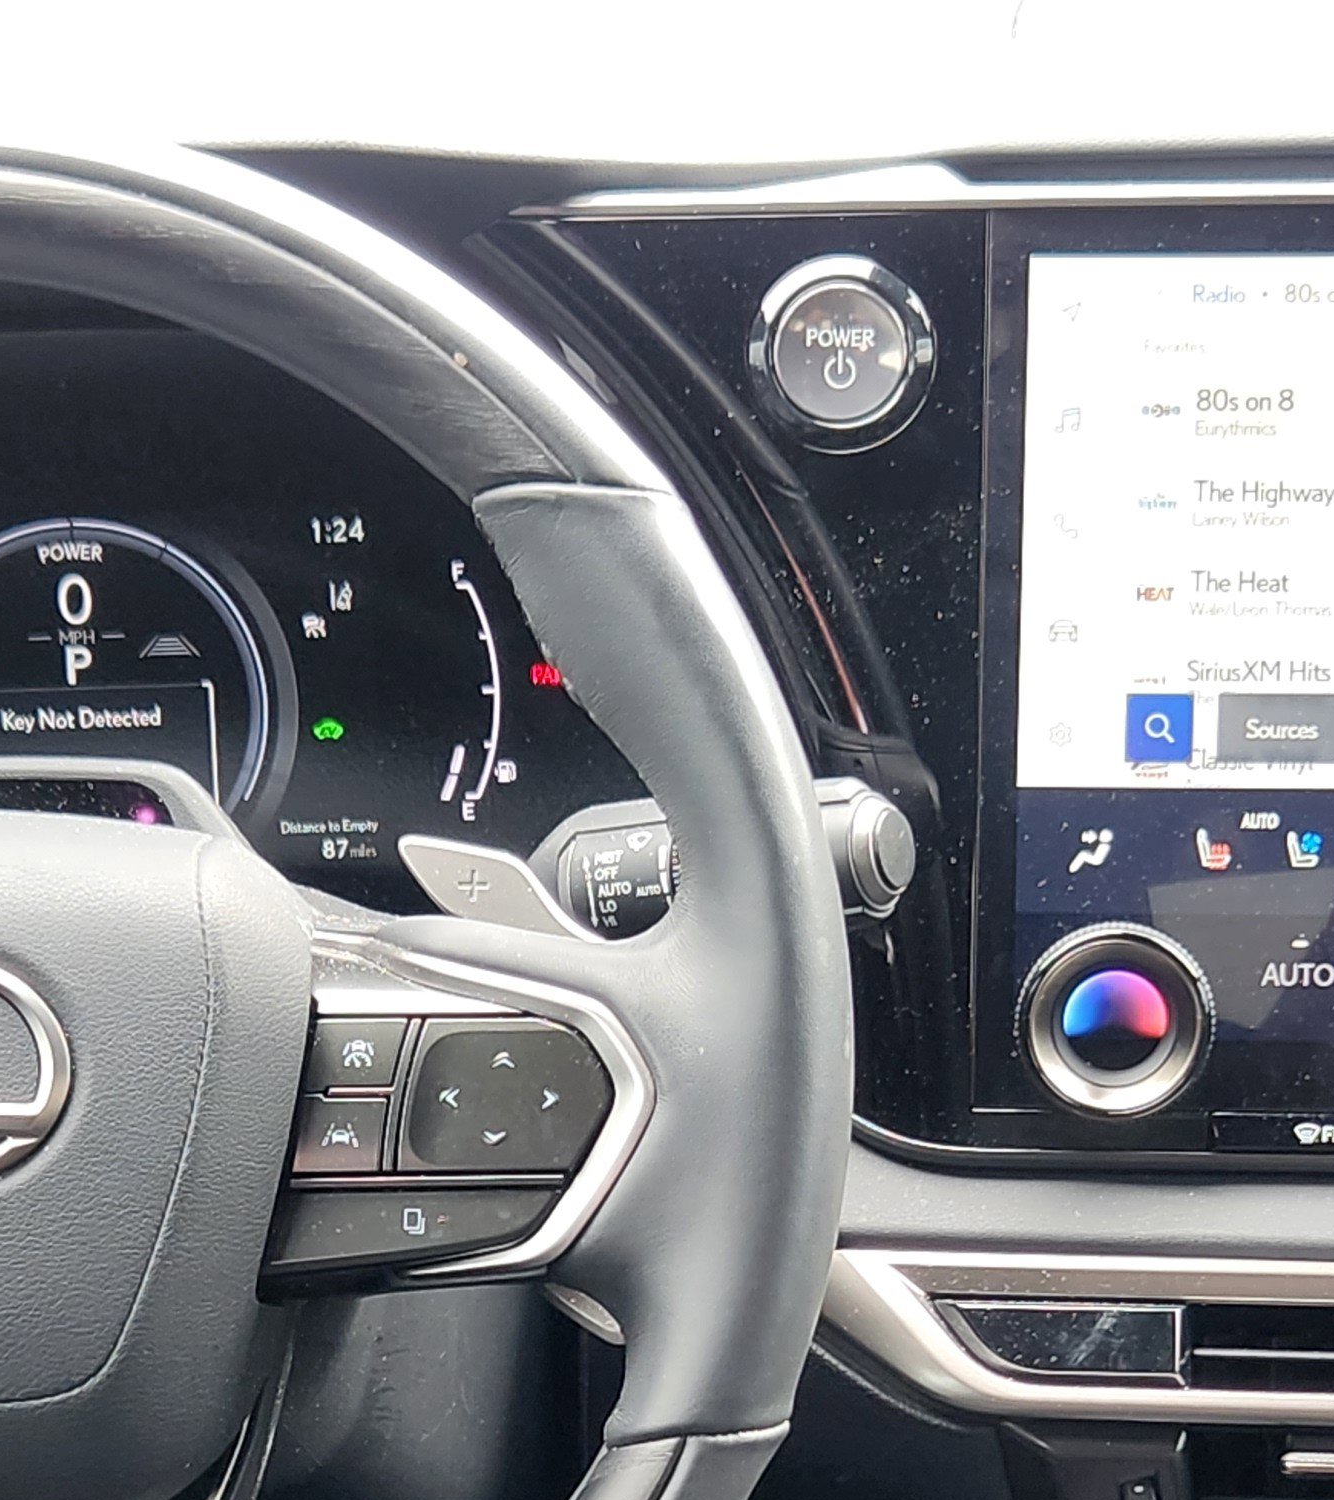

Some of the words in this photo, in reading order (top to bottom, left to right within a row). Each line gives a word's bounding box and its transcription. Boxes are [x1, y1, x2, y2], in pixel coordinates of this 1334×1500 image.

[1192, 284, 1246, 303] Radio
[1284, 283, 1320, 303] 80s
[805, 328, 876, 348] POWER
[1196, 388, 1239, 412] 80s
[1245, 397, 1272, 412] on
[1278, 388, 1295, 412] 8
[1195, 419, 1277, 439] Eurythmics
[1193, 480, 1235, 503] The
[311, 514, 365, 544] 1:24
[37, 543, 103, 565] POWER
[451, 558, 465, 582] F
[1191, 570, 1231, 593] The
[1238, 570, 1289, 593] Heat
[57, 573, 93, 626] 0
[1136, 587, 1174, 602] HEAT
[58, 629, 96, 646] MPH
[64, 645, 93, 686] P
[1187, 659, 1280, 682] SiriusXM
[1289, 660, 1331, 682] Hits
[0, 708, 34, 734] Key
[38, 706, 75, 731] Not
[77, 704, 162, 730] Detected
[1245, 718, 1319, 740] Sources
[462, 800, 476, 822] E
[1239, 812, 1281, 831] AUTO
[279, 819, 326, 835] Distance
[328, 819, 340, 833] to
[341, 817, 379, 834] Empty
[321, 837, 349, 860] 87
[350, 843, 377, 859] miles
[594, 866, 619, 881] OFF
[598, 881, 632, 898] AUTO
[635, 884, 661, 898] AUTO
[598, 899, 618, 914] LO
